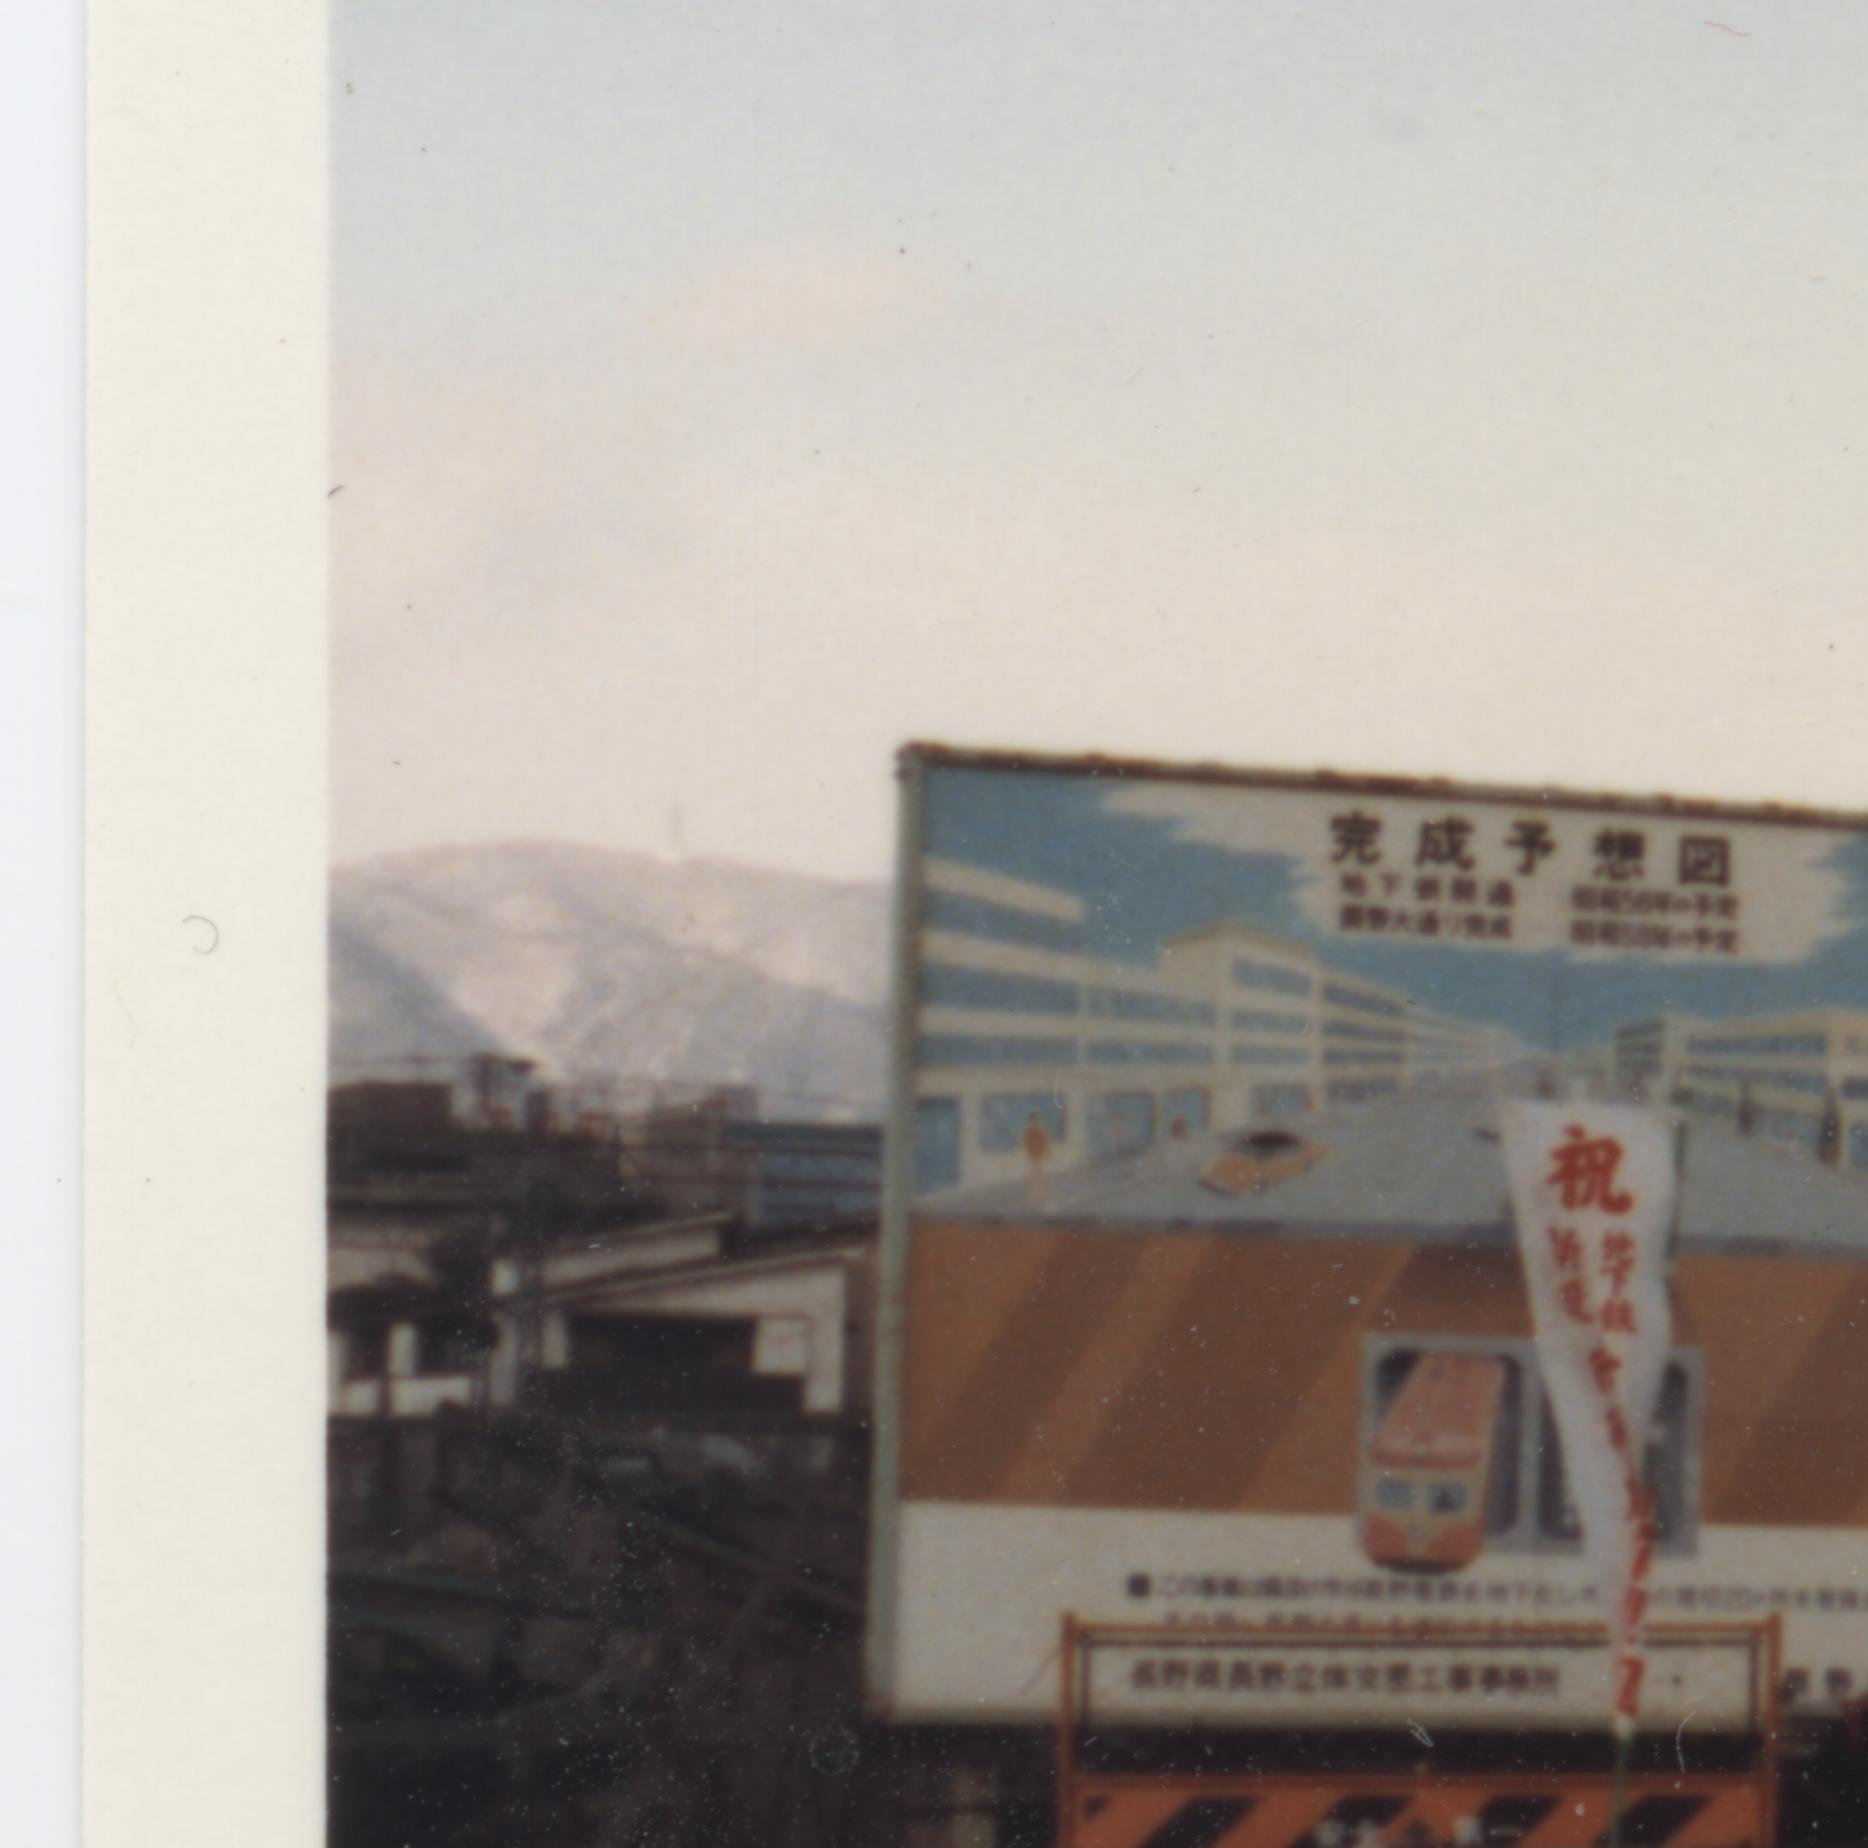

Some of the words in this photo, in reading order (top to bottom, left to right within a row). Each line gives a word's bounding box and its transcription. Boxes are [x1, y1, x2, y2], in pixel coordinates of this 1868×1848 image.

[1328, 810, 1733, 888] 完成予想図
[1548, 1122, 1633, 1214] 祝
